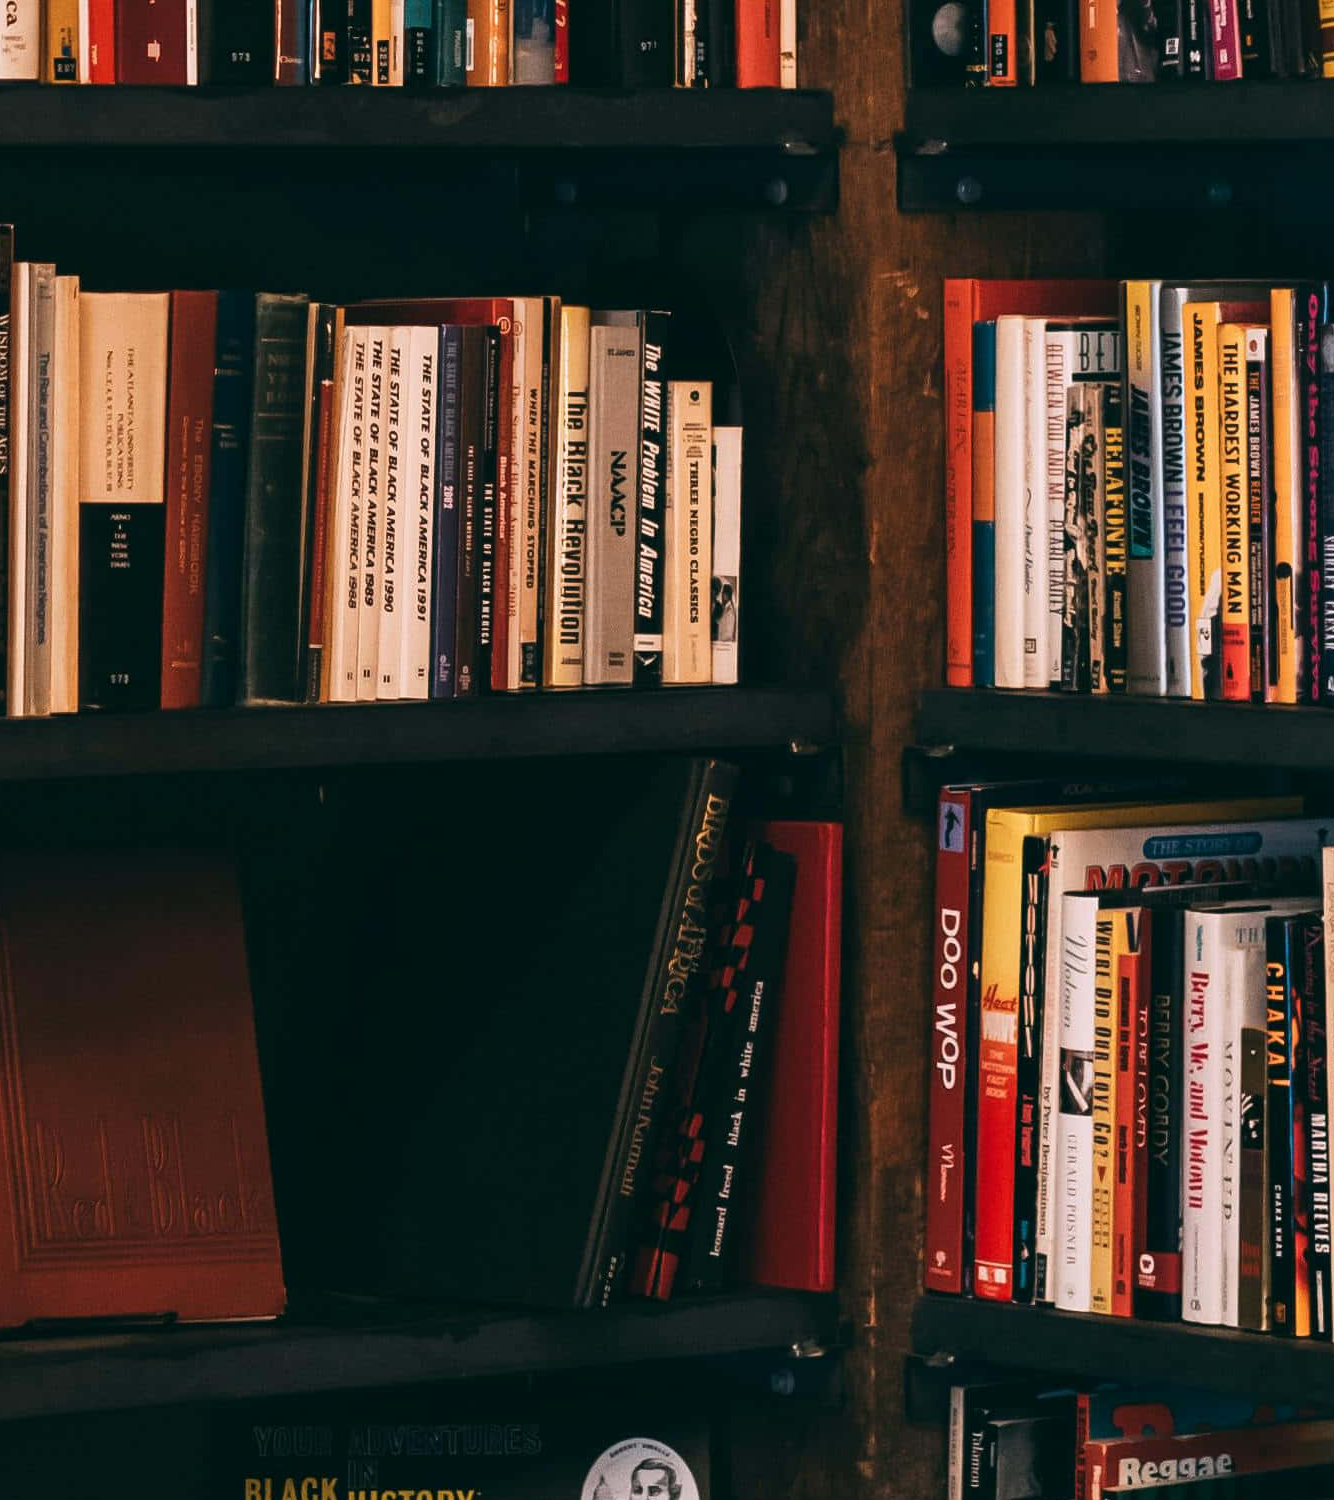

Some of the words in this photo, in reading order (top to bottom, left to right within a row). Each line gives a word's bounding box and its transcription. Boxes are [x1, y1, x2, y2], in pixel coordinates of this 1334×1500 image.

[422, 355, 433, 384] THE
[421, 387, 432, 433] STATE
[564, 391, 587, 431] The
[419, 435, 431, 457] OF
[418, 463, 430, 512] BLACK
[563, 441, 587, 509] Black
[689, 461, 700, 504] THREE
[1105, 427, 1126, 576] BELAFONTE
[417, 515, 428, 584] AMERICA
[689, 509, 700, 555] NEGRO
[417, 589, 427, 622] 1991
[560, 519, 585, 645] Revolution
[689, 559, 700, 624] CLASSICS
[940, 908, 960, 989] DOO
[935, 1003, 958, 1089] WOP
